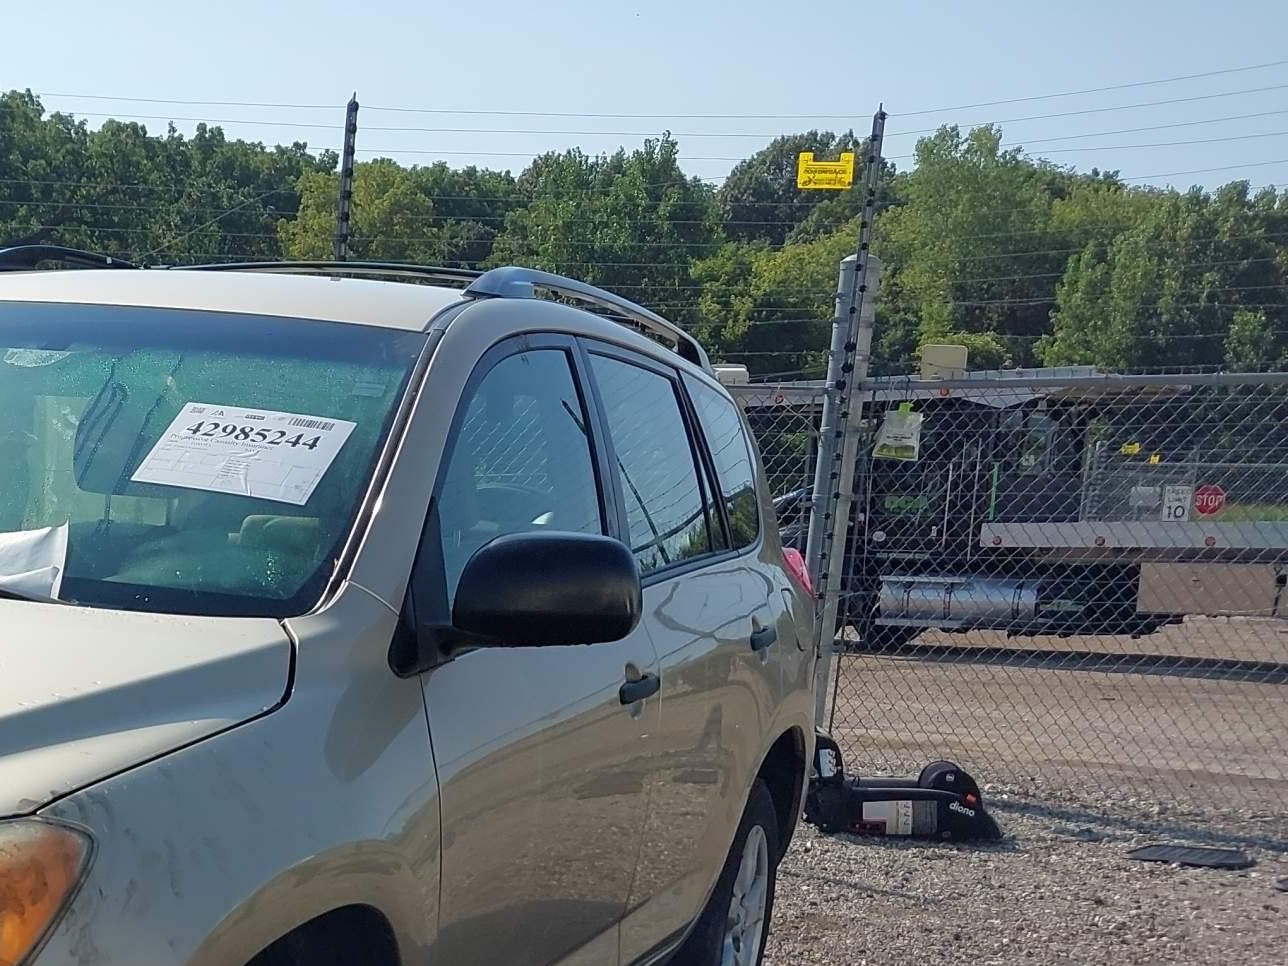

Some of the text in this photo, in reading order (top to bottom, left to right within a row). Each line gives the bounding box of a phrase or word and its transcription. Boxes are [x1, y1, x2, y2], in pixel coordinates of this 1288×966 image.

[186, 420, 321, 450] 42985244
[1196, 495, 1223, 506] STOP
[1167, 505, 1185, 519] 10
[949, 801, 975, 816] diono
